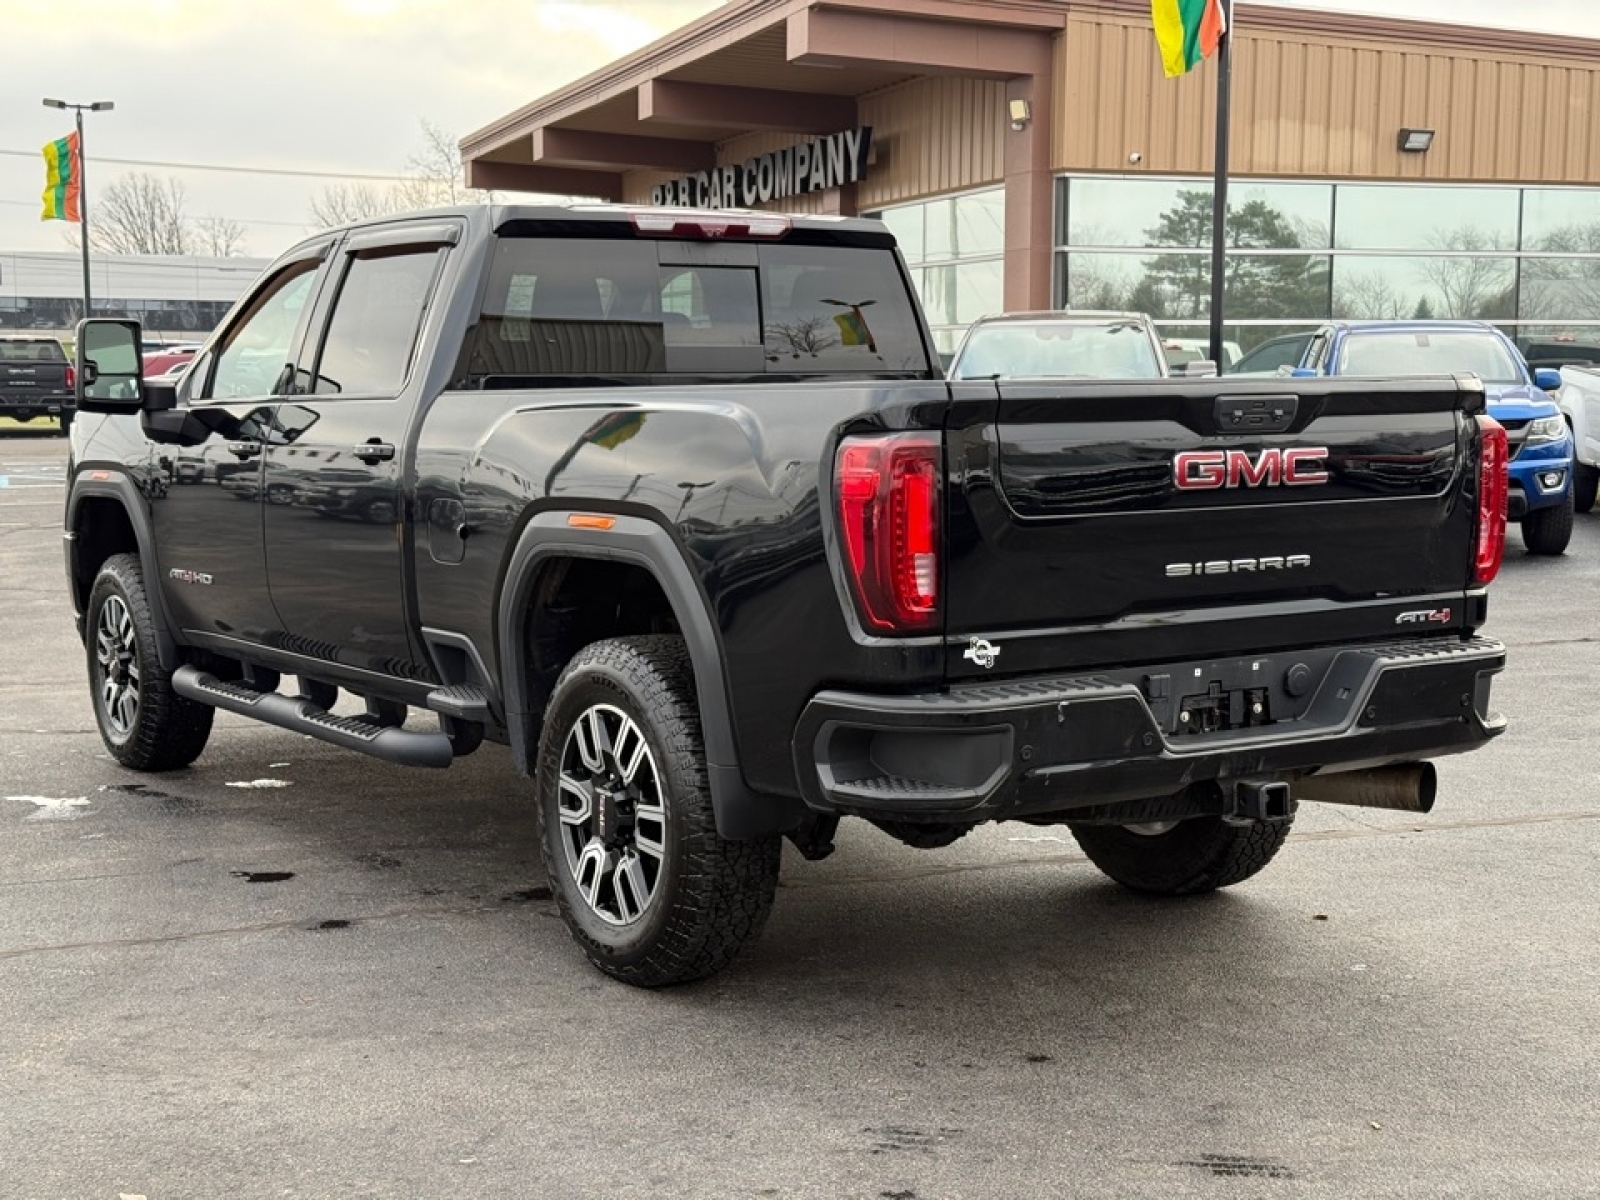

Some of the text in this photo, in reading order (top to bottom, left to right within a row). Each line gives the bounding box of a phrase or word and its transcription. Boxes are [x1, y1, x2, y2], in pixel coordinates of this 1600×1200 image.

[696, 164, 737, 210] CAR
[742, 127, 865, 206] COMPANY
[1173, 447, 1329, 491] GMC
[1164, 554, 1311, 578] SIERRA
[1394, 607, 1451, 624] AT4
